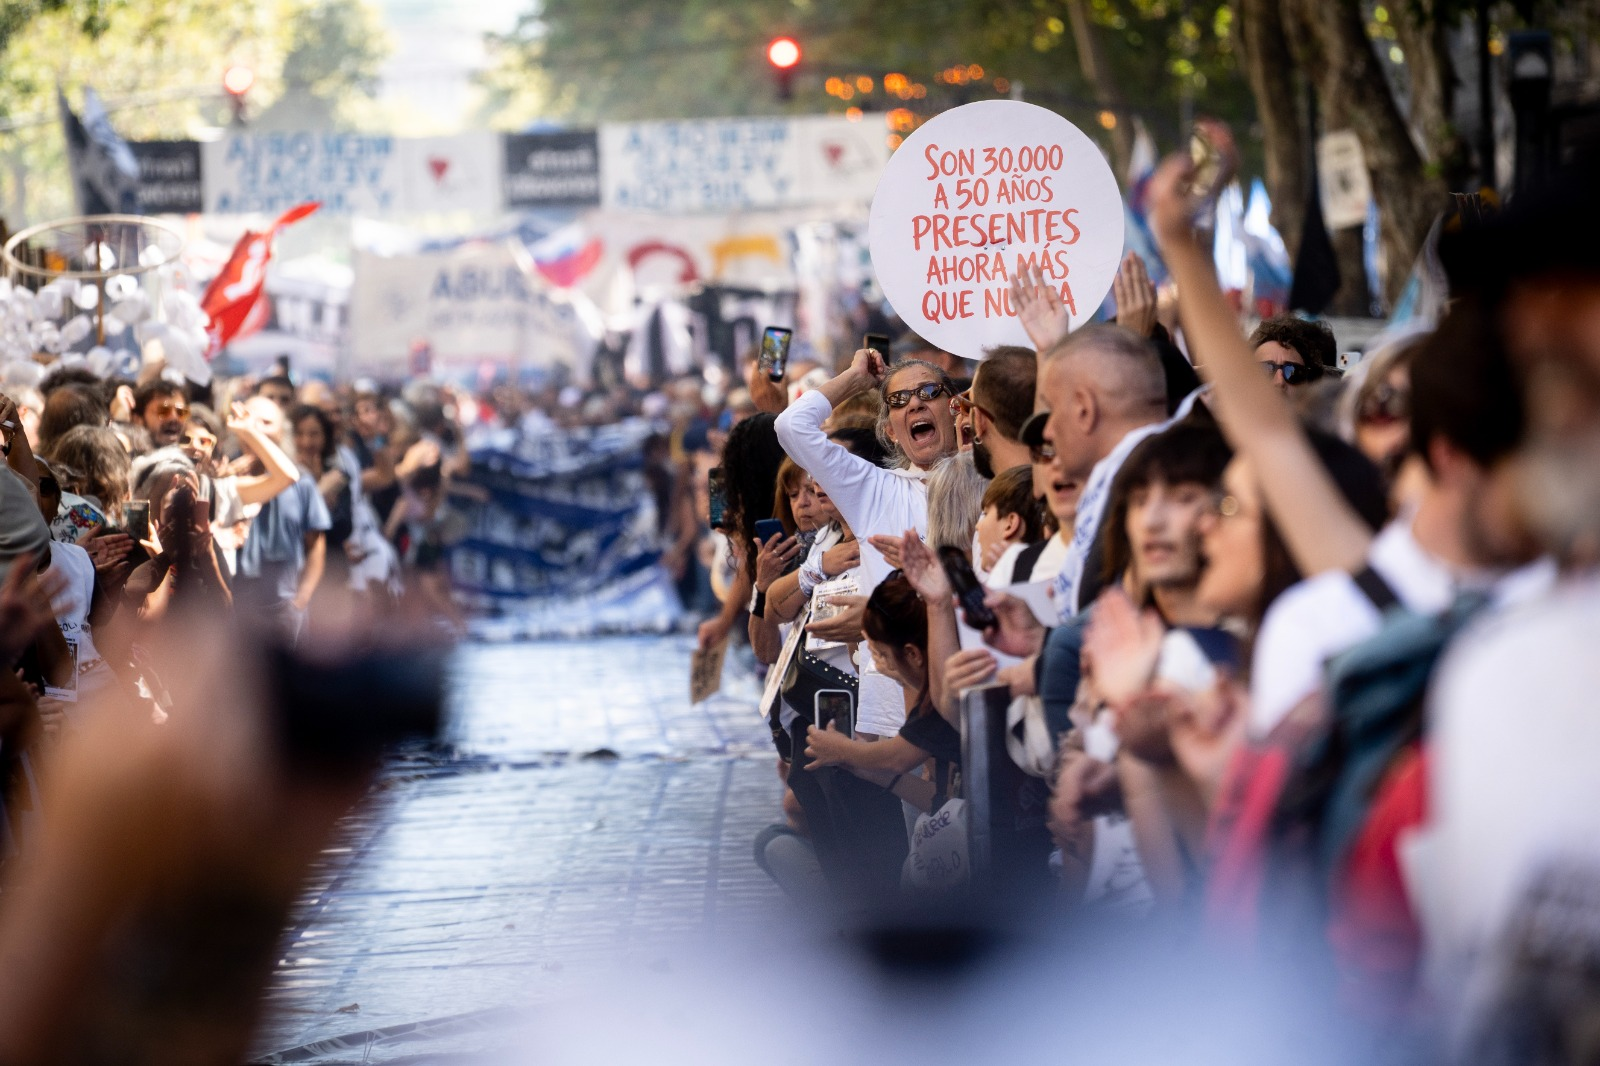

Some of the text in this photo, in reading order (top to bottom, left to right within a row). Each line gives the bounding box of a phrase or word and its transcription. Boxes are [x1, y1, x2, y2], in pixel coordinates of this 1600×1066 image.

[925, 144, 1063, 180] SON 30.000
[934, 174, 1054, 210] A 50 AÑOS
[912, 208, 1080, 251] PRESENTES
[926, 243, 1070, 286] AHORA MÁS
[922, 281, 1077, 324] QUE NUA
